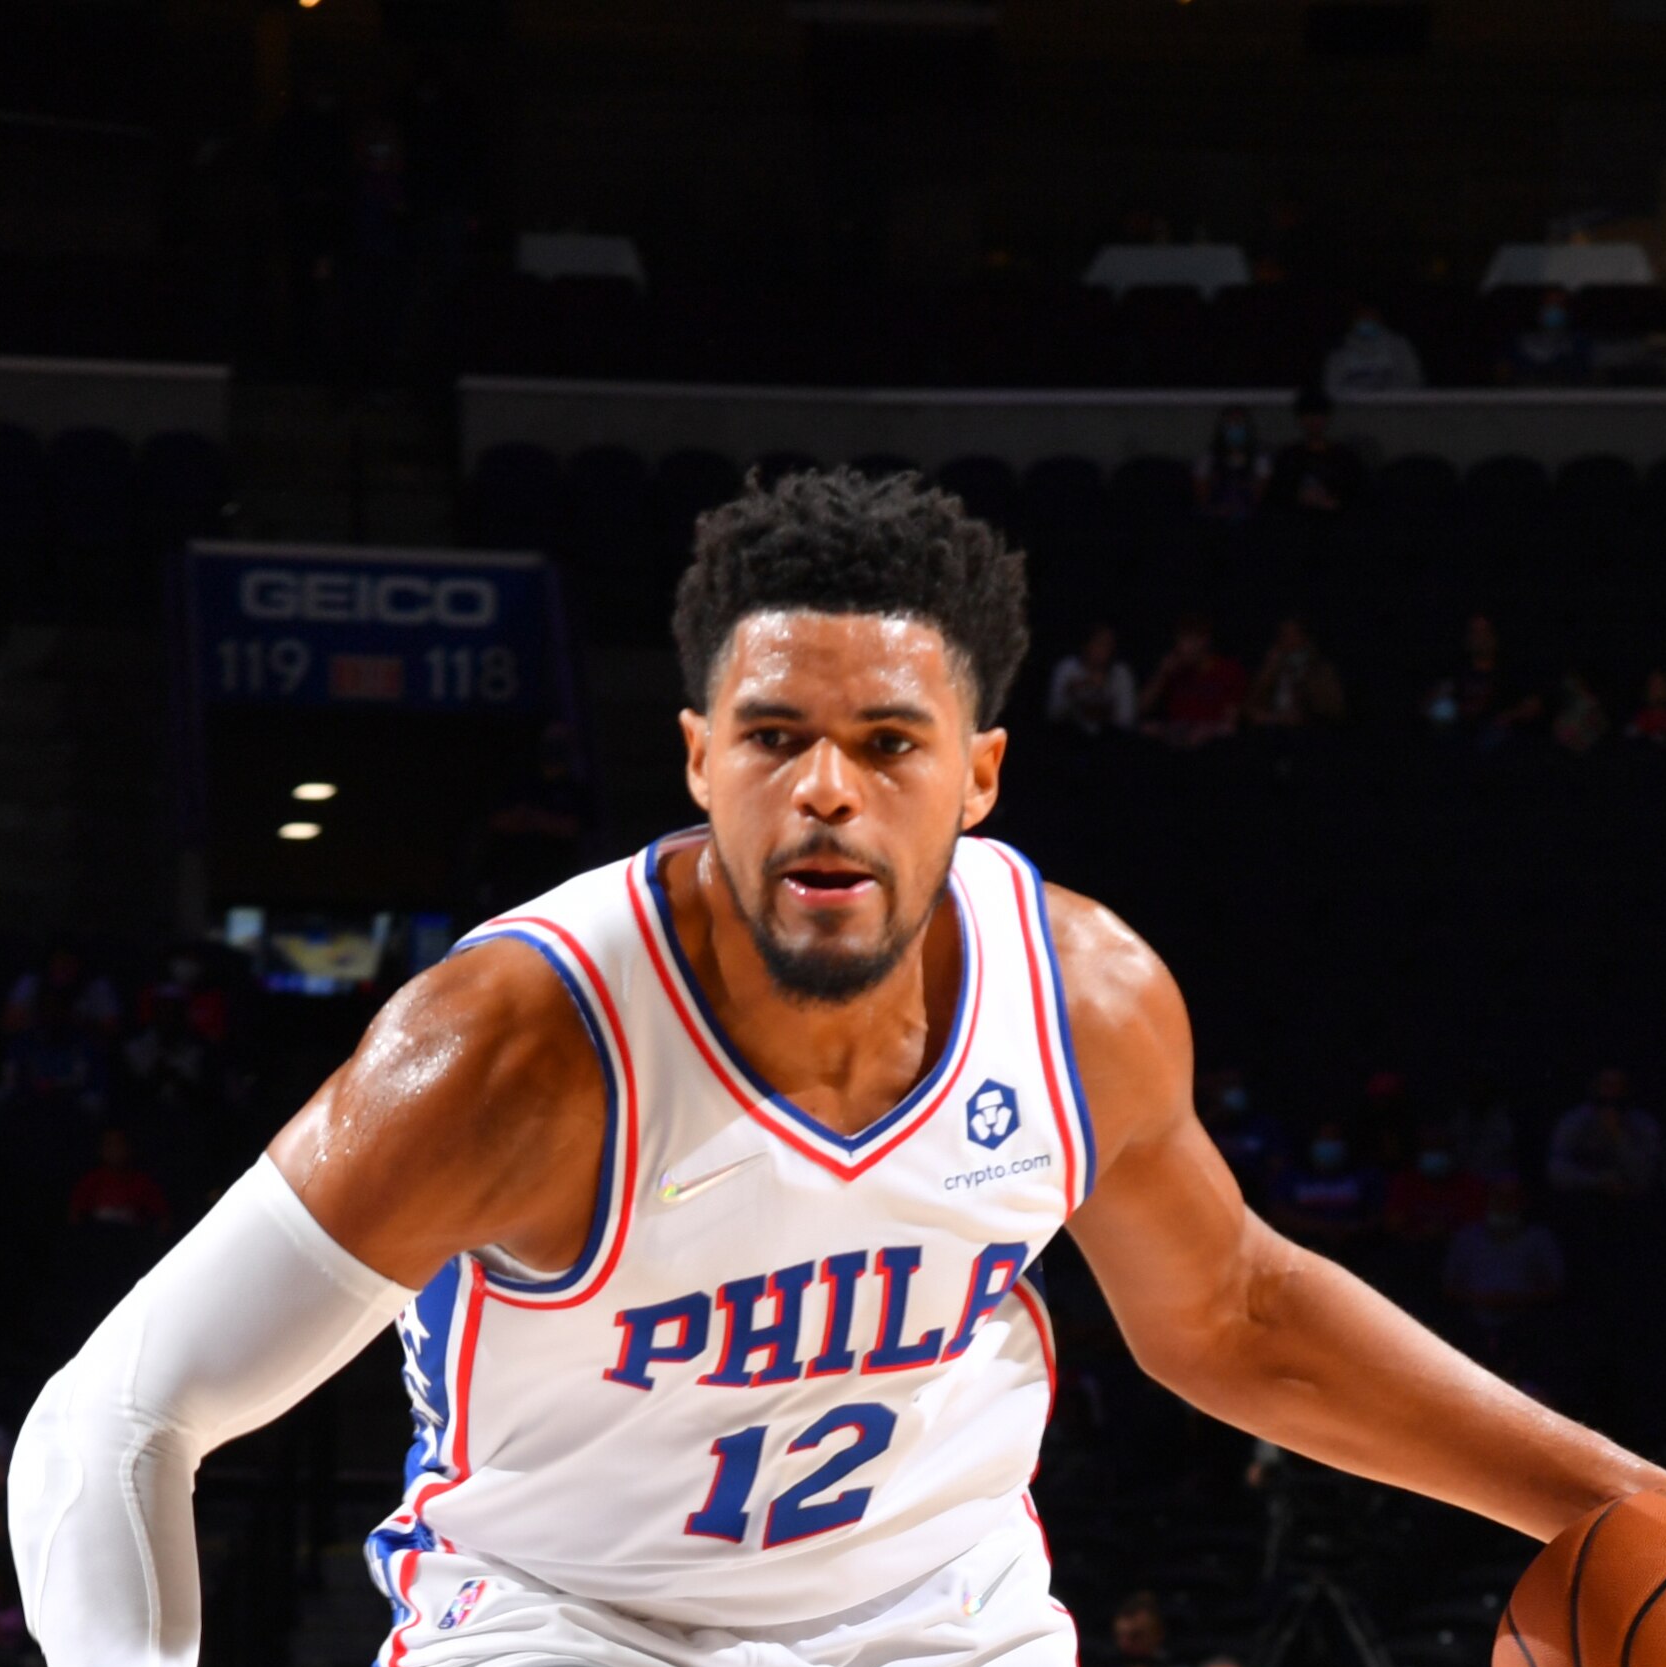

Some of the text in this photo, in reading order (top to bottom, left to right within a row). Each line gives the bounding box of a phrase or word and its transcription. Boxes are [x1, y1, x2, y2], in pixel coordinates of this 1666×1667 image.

[239, 568, 500, 629] GEICO
[218, 637, 519, 700] 119 118
[944, 1153, 1051, 1190] crypto.com
[603, 1241, 1030, 1391] PHILA
[683, 1402, 898, 1550] 12
